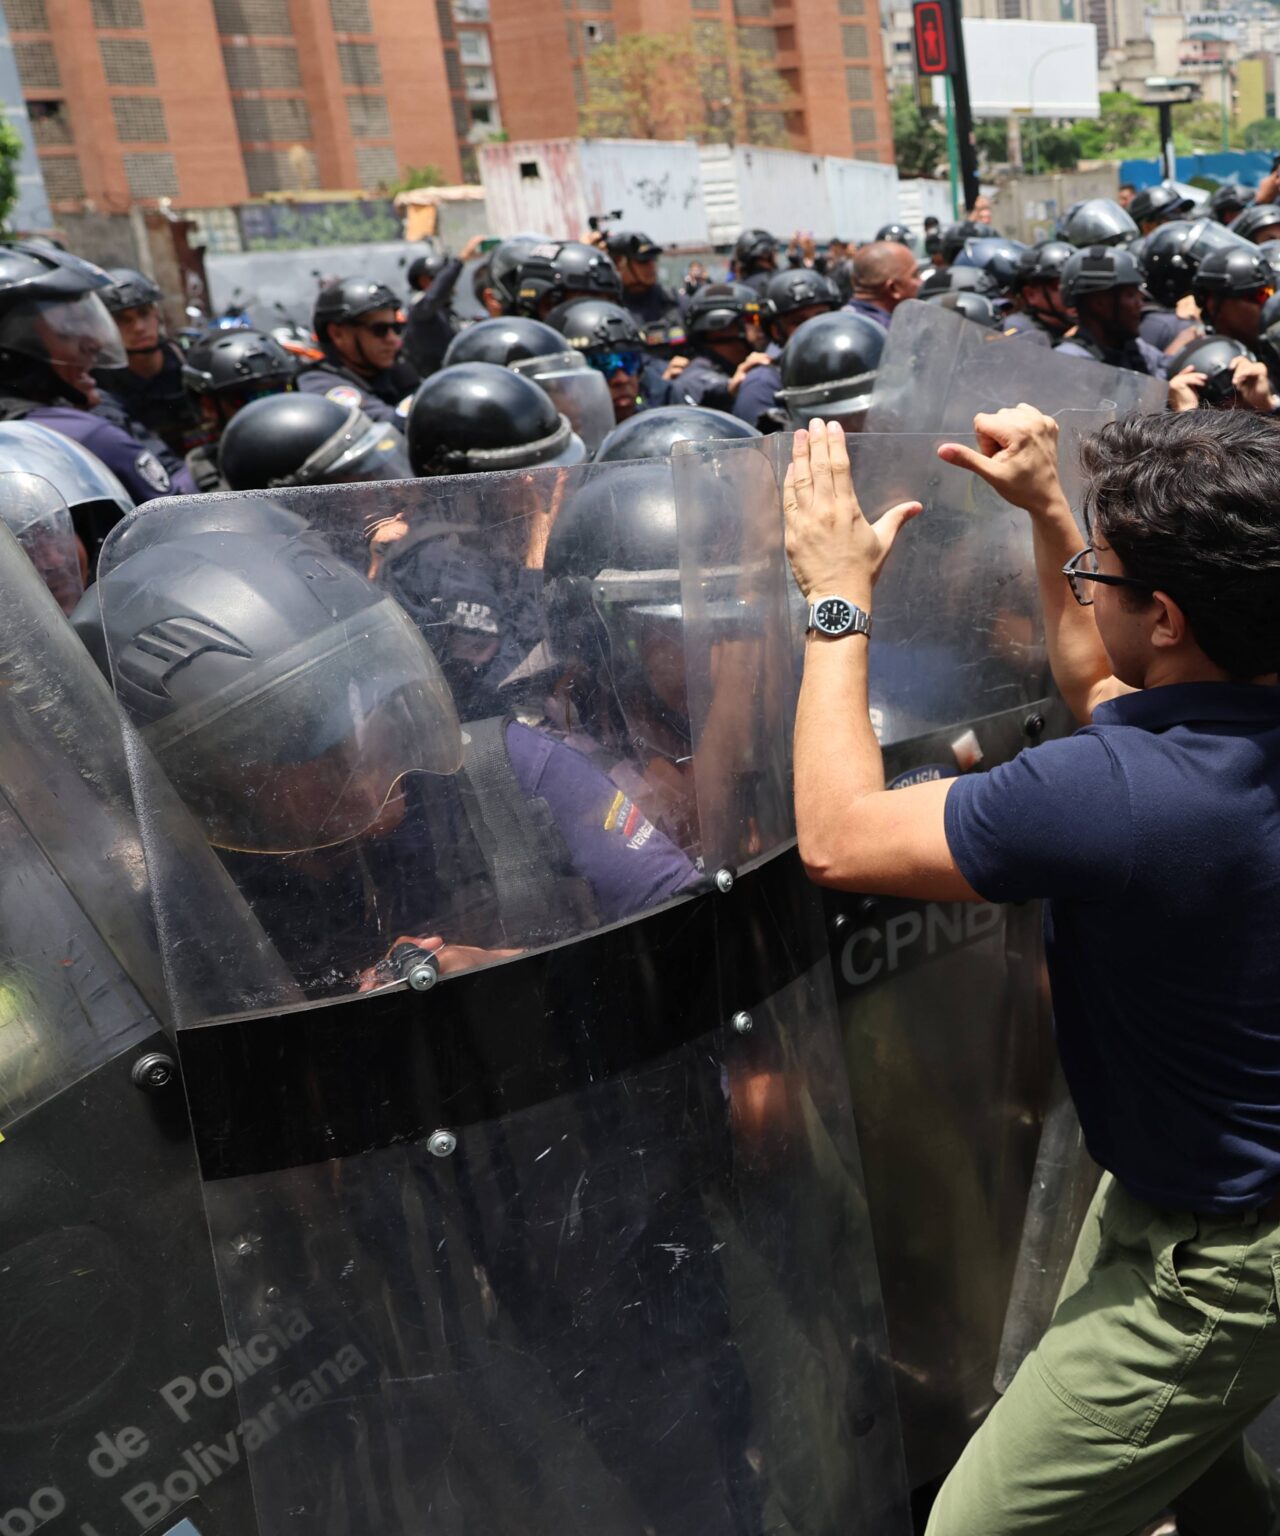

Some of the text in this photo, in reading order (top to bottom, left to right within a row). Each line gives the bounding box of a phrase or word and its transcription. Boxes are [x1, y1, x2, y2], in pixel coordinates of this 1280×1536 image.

[840, 901, 1001, 986] CPNB
[87, 1425, 151, 1479] de
[120, 1343, 368, 1530] Bolivariana
